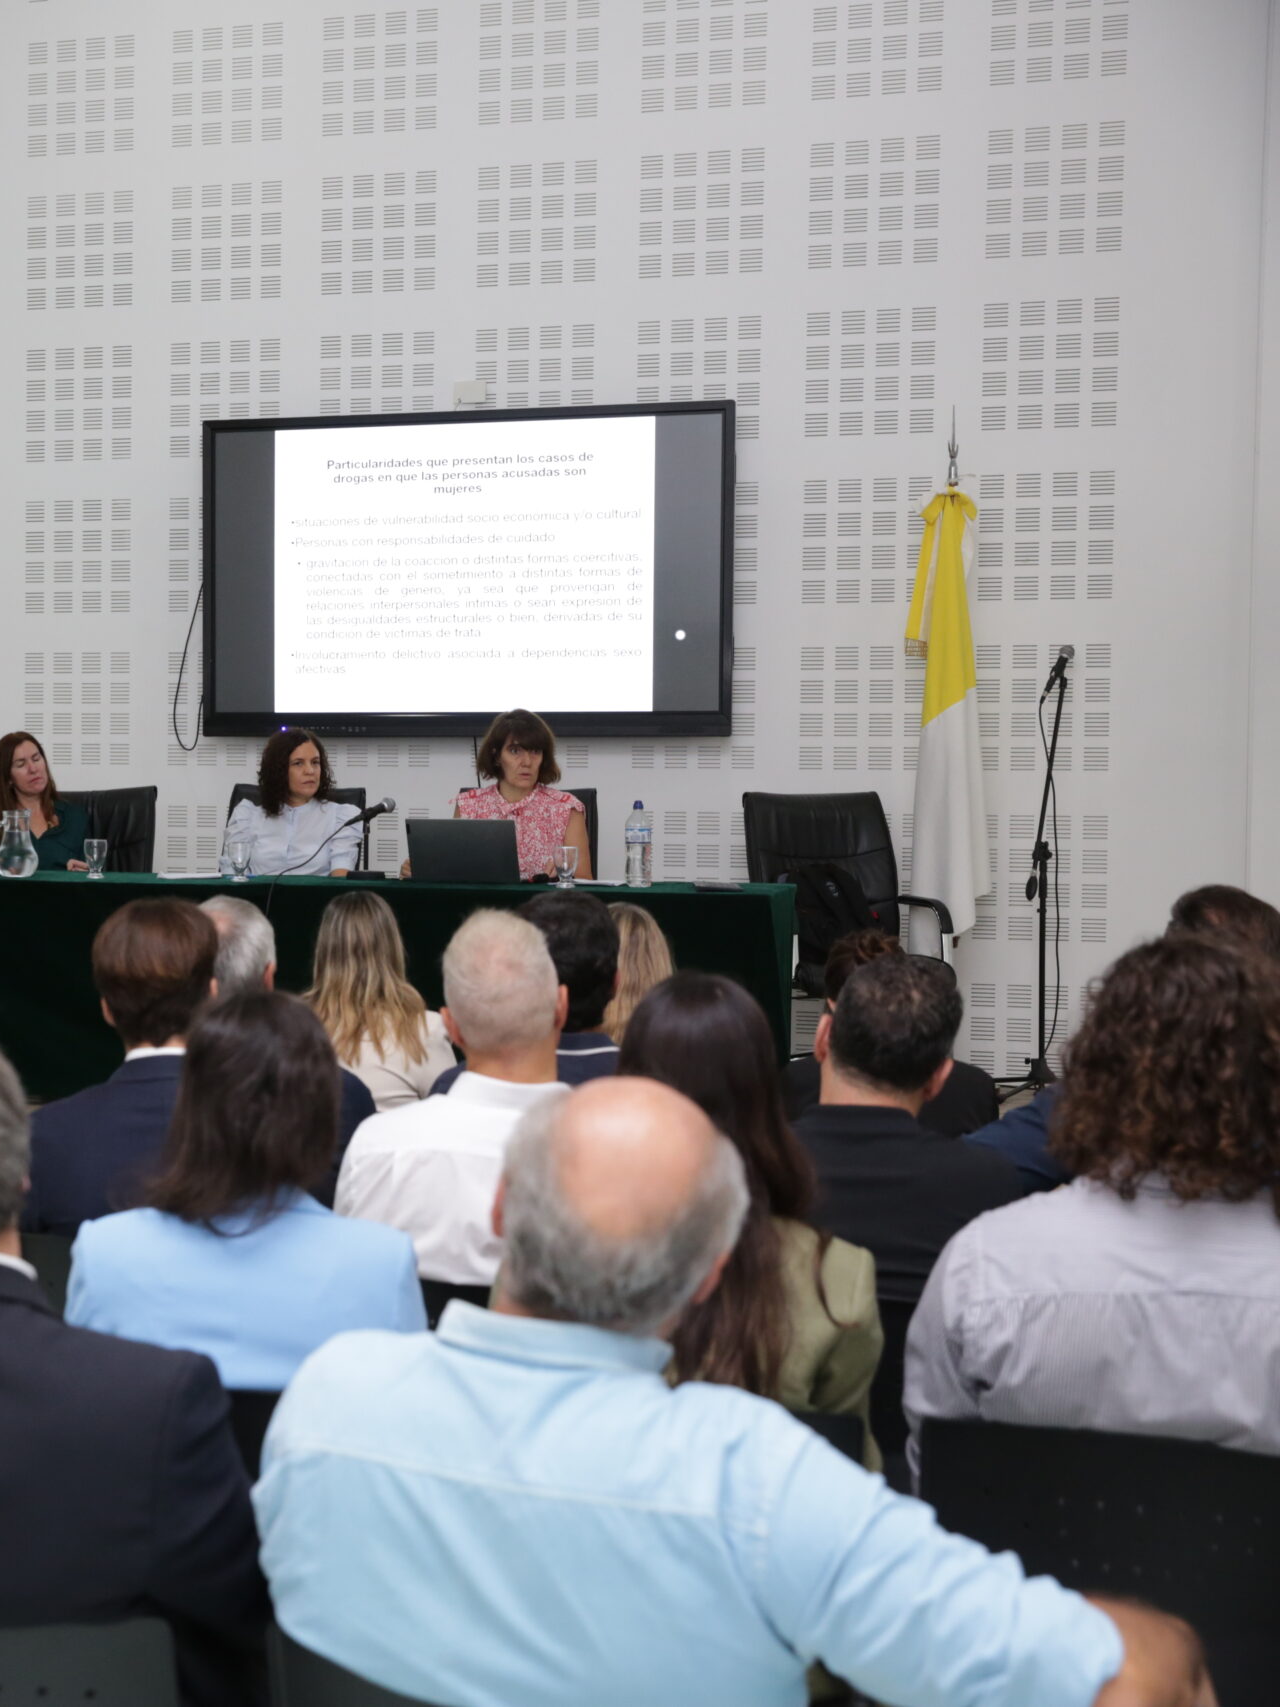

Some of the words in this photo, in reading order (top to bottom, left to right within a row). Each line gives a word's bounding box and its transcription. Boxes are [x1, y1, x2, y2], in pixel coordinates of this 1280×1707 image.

[327, 458, 422, 469] Particularidades
[426, 458, 448, 469] que
[452, 455, 512, 467] presentan
[517, 453, 534, 463] los
[538, 454, 575, 462] casos
[578, 451, 594, 461] de
[333, 474, 374, 485] drogas
[396, 473, 417, 484] que
[421, 471, 438, 480] las
[442, 471, 498, 482] personas
[502, 467, 560, 477] acusadas
[564, 468, 586, 476] son
[434, 485, 482, 496] mujeres
[296, 518, 359, 526] situaciones
[363, 515, 378, 525] de
[382, 514, 463, 524] vulnerabilidad
[467, 514, 499, 522] socio
[573, 511, 592, 522] y/o
[596, 509, 641, 519] cultural
[296, 536, 348, 547] Personas
[352, 538, 373, 546] con
[377, 534, 484, 546] responsabilidades
[488, 533, 503, 543] de
[506, 532, 555, 542] cuidado
[373, 557, 387, 566] de
[392, 556, 401, 566] la
[462, 556, 469, 564] o
[473, 554, 524, 564] distintas
[528, 553, 569, 563] formas
[306, 572, 373, 582] conectadas
[379, 572, 401, 580] con
[407, 570, 417, 580] el
[423, 569, 503, 579] sometimiento
[509, 570, 516, 578] a
[521, 568, 573, 578] distintas
[579, 567, 621, 576] formas
[627, 566, 642, 576] de
[306, 587, 363, 596] violencias
[374, 586, 389, 595] de
[457, 586, 471, 596] ya
[483, 585, 504, 593] sea
[515, 584, 539, 595] que
[550, 583, 615, 594] provengan
[627, 581, 642, 590] de
[306, 601, 365, 610] relaciones
[370, 600, 460, 610] interpersonales
[514, 599, 522, 607] o
[528, 599, 556, 607] sean
[627, 595, 642, 605] de
[307, 615, 322, 624] las
[327, 614, 411, 625] desigualdades
[416, 613, 492, 623] estructurales
[497, 614, 504, 622] o
[544, 612, 602, 621] derivadas
[607, 611, 623, 620] de
[628, 612, 642, 620] su
[366, 629, 380, 638] de
[436, 628, 451, 637] de
[455, 628, 481, 637] trata
[392, 649, 441, 659] delictivo
[448, 649, 501, 658] asociada
[507, 650, 515, 658] a
[521, 648, 607, 659] dependencias
[613, 648, 642, 656] sexo
